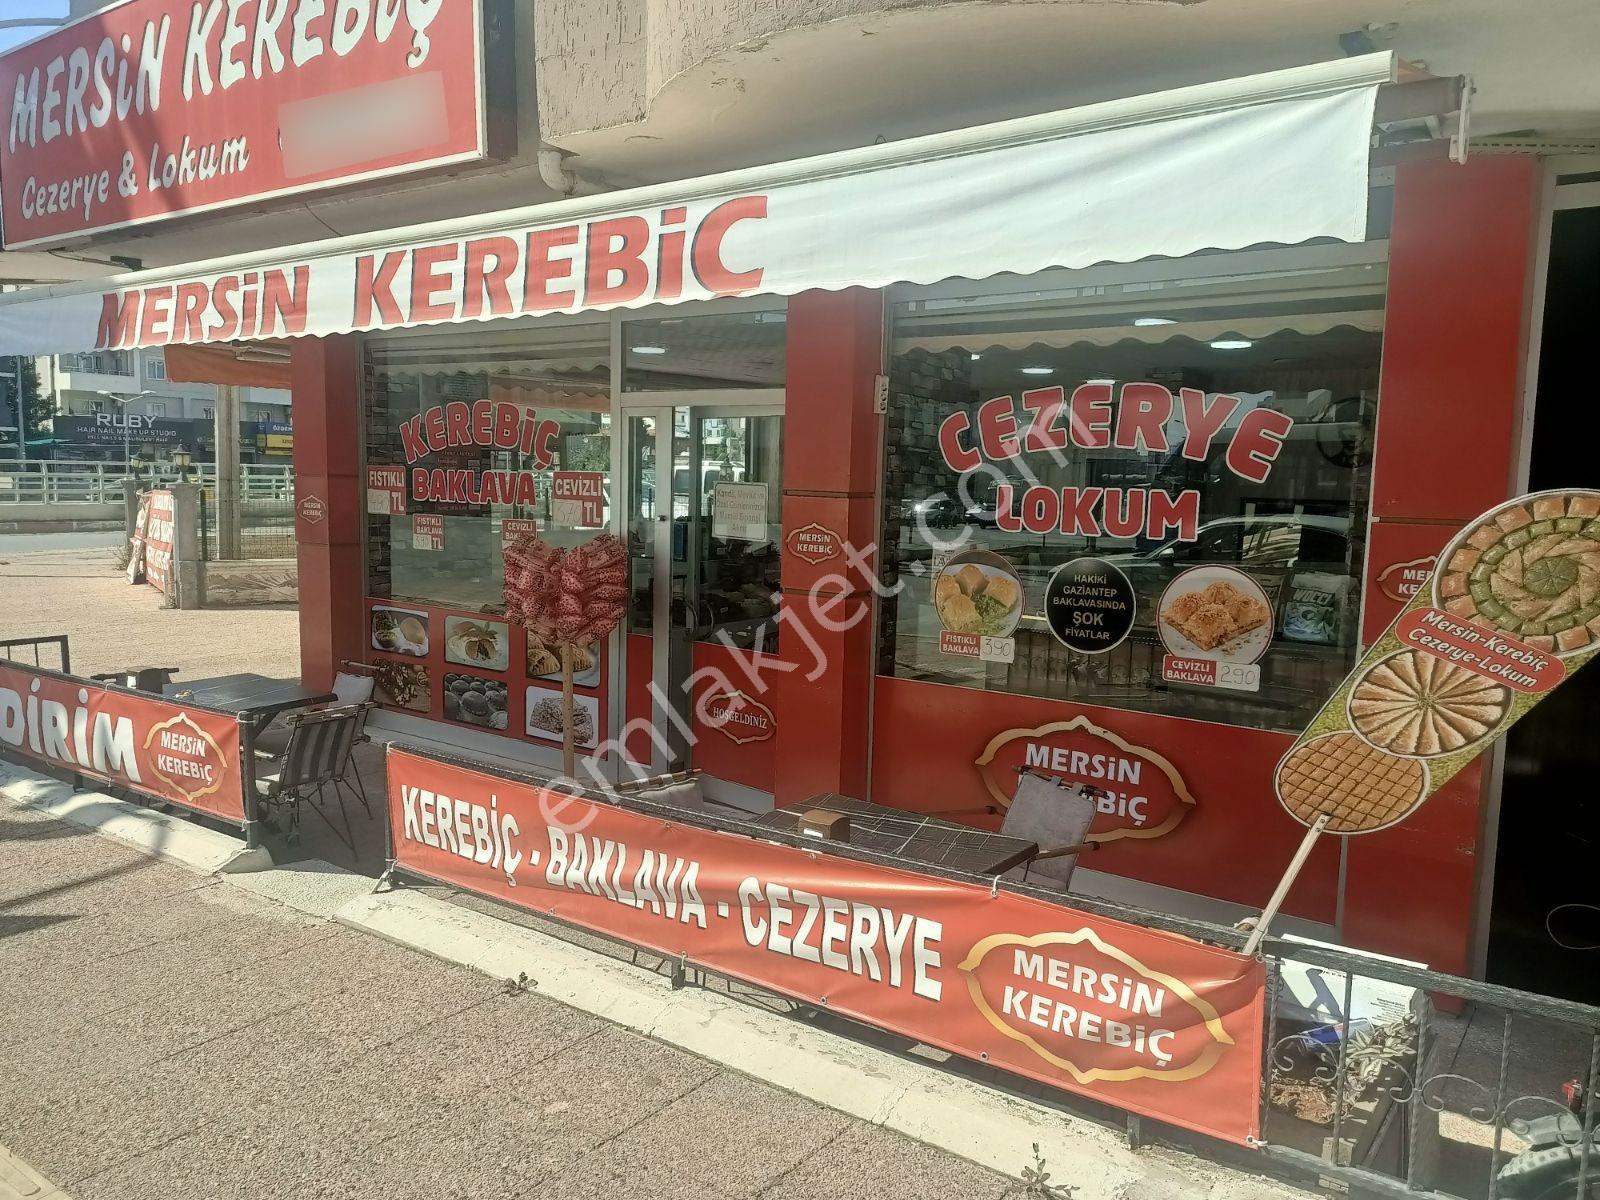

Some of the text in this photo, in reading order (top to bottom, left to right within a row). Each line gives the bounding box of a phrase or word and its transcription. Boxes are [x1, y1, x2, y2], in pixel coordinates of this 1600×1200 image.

[21, 135, 250, 221] Cezerye & Lokum
[96, 413, 157, 428] RUBY
[77, 426, 97, 434] HAIR
[98, 427, 115, 435] NAIL
[150, 429, 177, 437] STUDIO
[938, 382, 1294, 484] CEZERYE
[369, 470, 405, 487] FISTIKLI
[555, 475, 601, 497] CEVİZLİ
[412, 468, 537, 507] BAKLAVA
[391, 491, 405, 511] TL
[583, 501, 601, 524] TL
[995, 484, 1201, 543] LOKUM
[417, 517, 442, 526] FISTIKLI
[416, 527, 443, 535] BAKLAVA
[432, 537, 443, 550] TL
[1074, 573, 1107, 585] HAKİKİ
[1063, 585, 1118, 598] GAZİANTEP
[1053, 596, 1126, 610] BAKLAVASINDA
[1072, 611, 1104, 627] ŞOK
[945, 634, 977, 645] FISTIKLI
[1065, 626, 1110, 640] FİYATLAR
[1420, 610, 1549, 672] Mersin-Kerebiç
[942, 643, 980, 655] BAKLAVA
[983, 638, 1011, 656] 390
[1172, 660, 1210, 673] CEVİZLİ
[1408, 628, 1538, 688] Cezerye-Lokum
[1166, 670, 1214, 684] BAKLAVA
[1220, 665, 1256, 685] 290
[1025, 743, 1142, 785] MERSiN
[545, 826, 708, 929] BAKLAVA
[738, 876, 944, 1002] CEZERYE
[1012, 948, 1166, 1018] MERSiN
